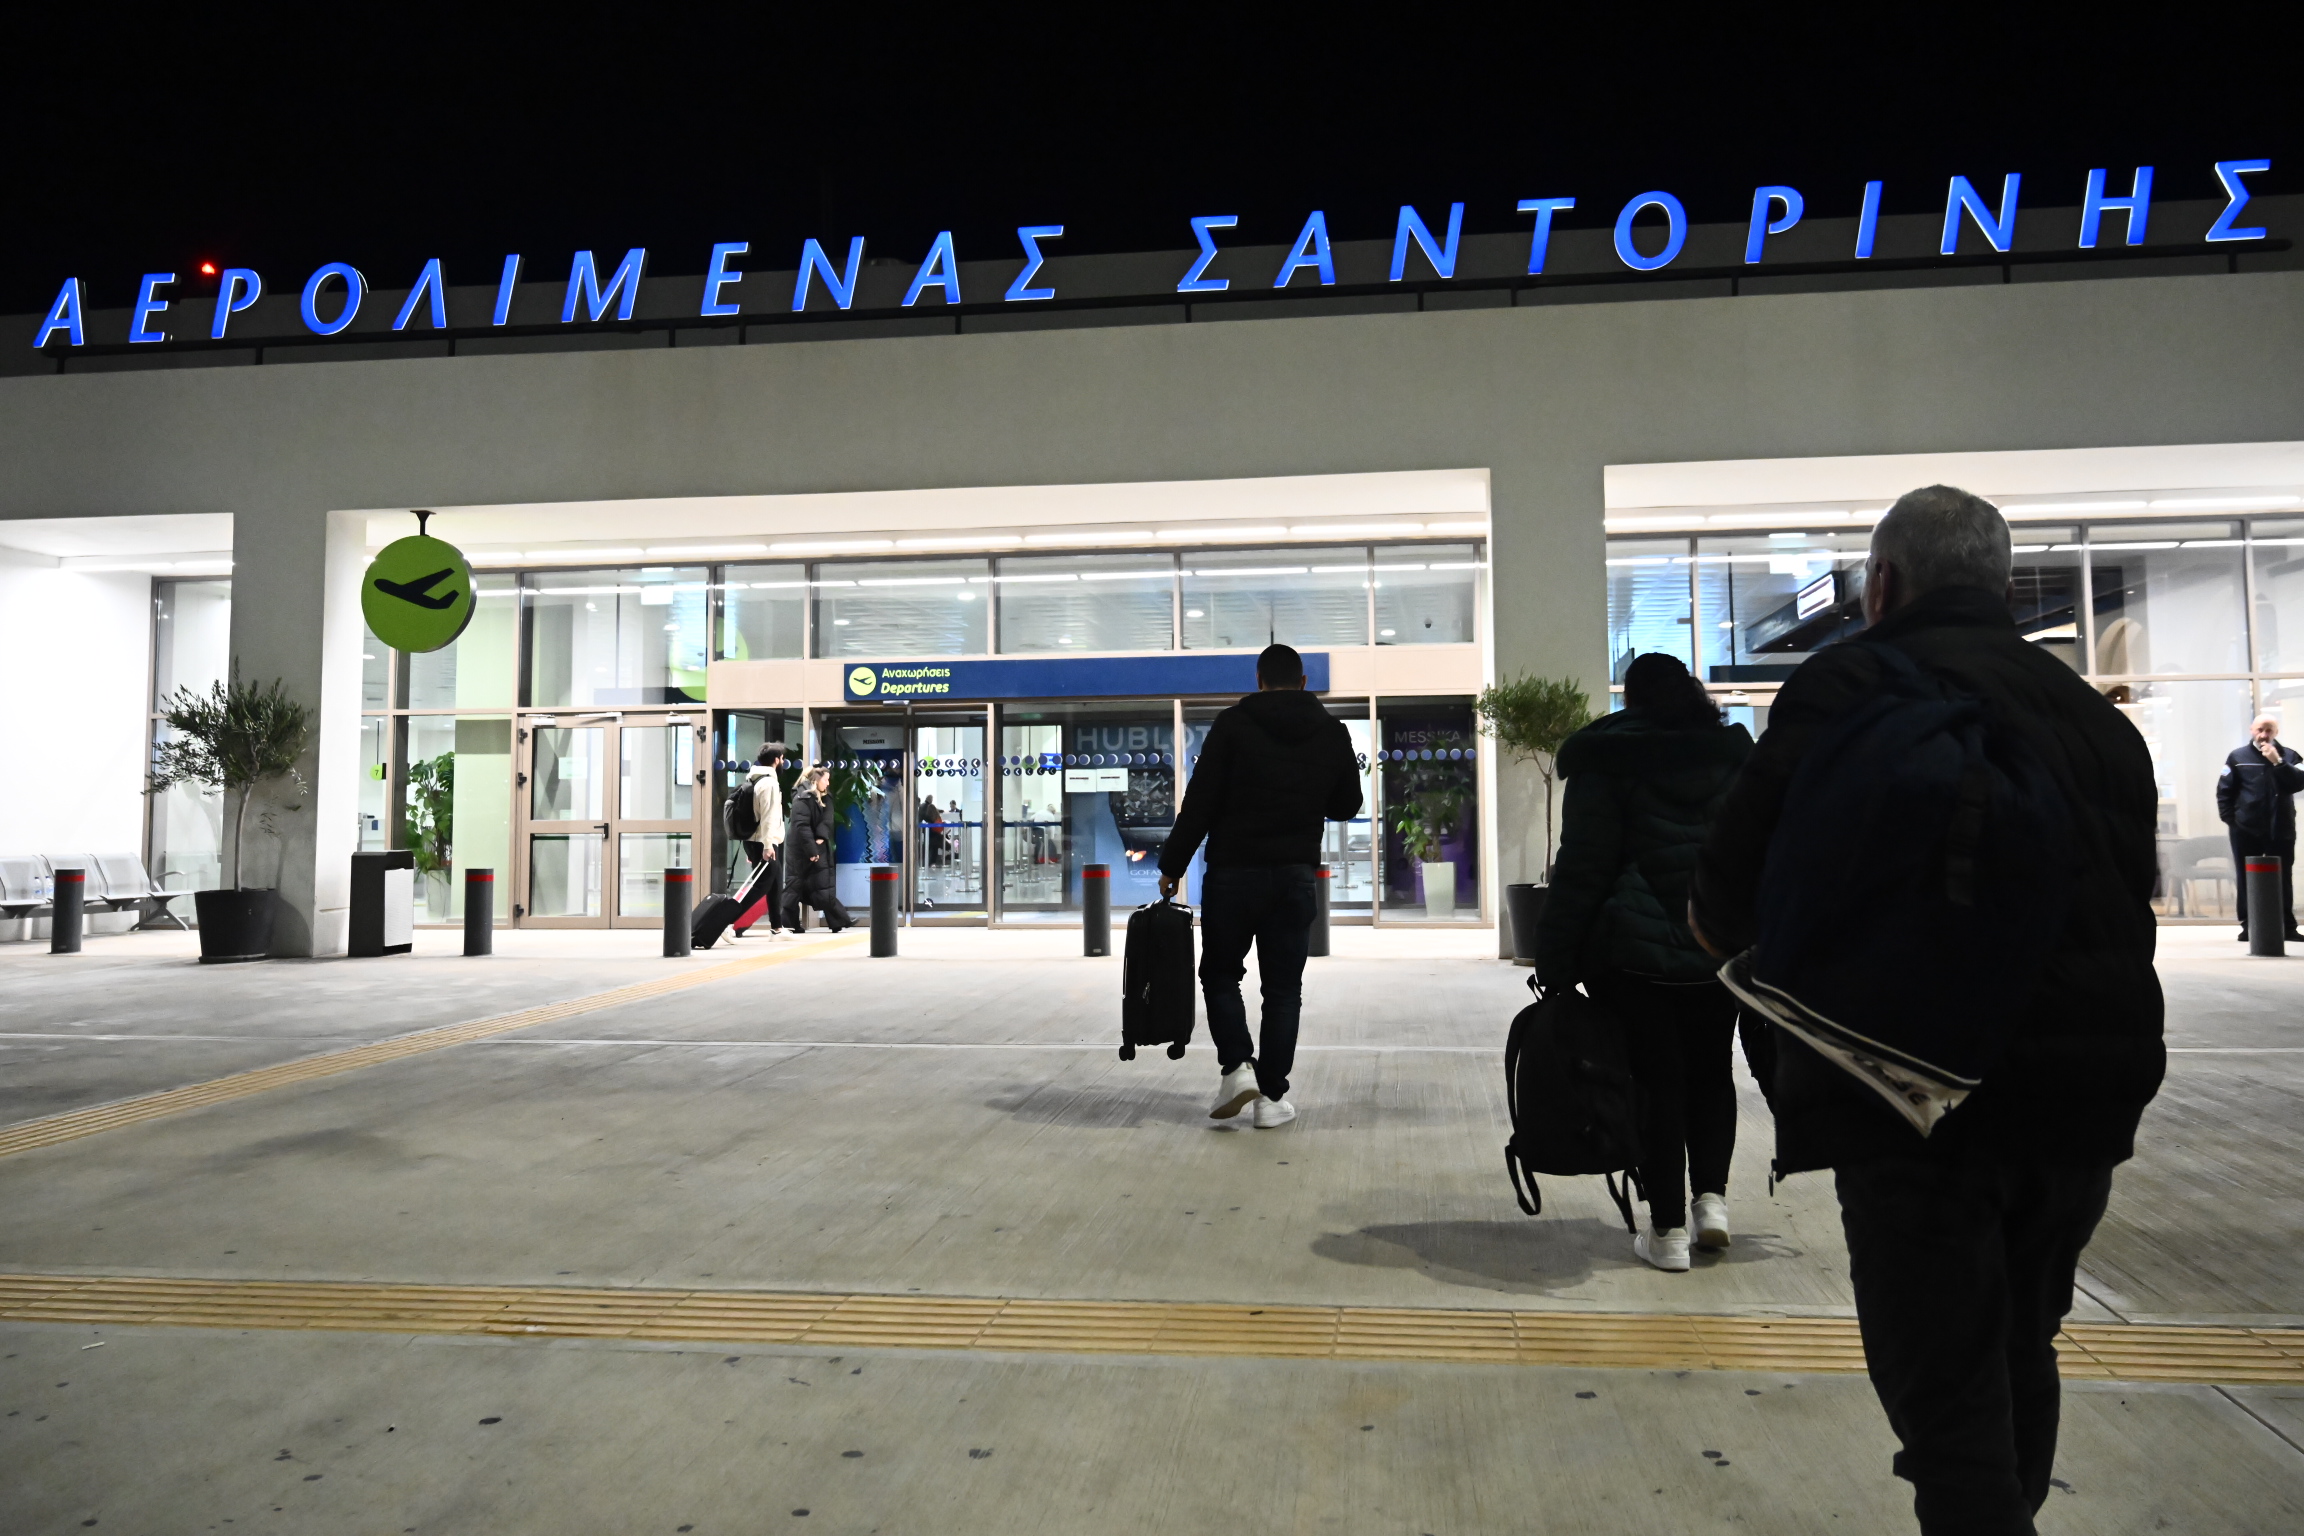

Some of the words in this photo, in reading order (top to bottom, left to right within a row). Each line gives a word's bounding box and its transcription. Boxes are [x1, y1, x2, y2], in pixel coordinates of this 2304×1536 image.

[33, 225, 1065, 349] ΑΕΡΟΛΙΜΕΝΑΣ
[1177, 158, 2272, 293] ΣΑΝΤΟΡΙΝΗΣ
[882, 666, 951, 680] Αναχωρήσεις
[880, 682, 950, 696] Departures
